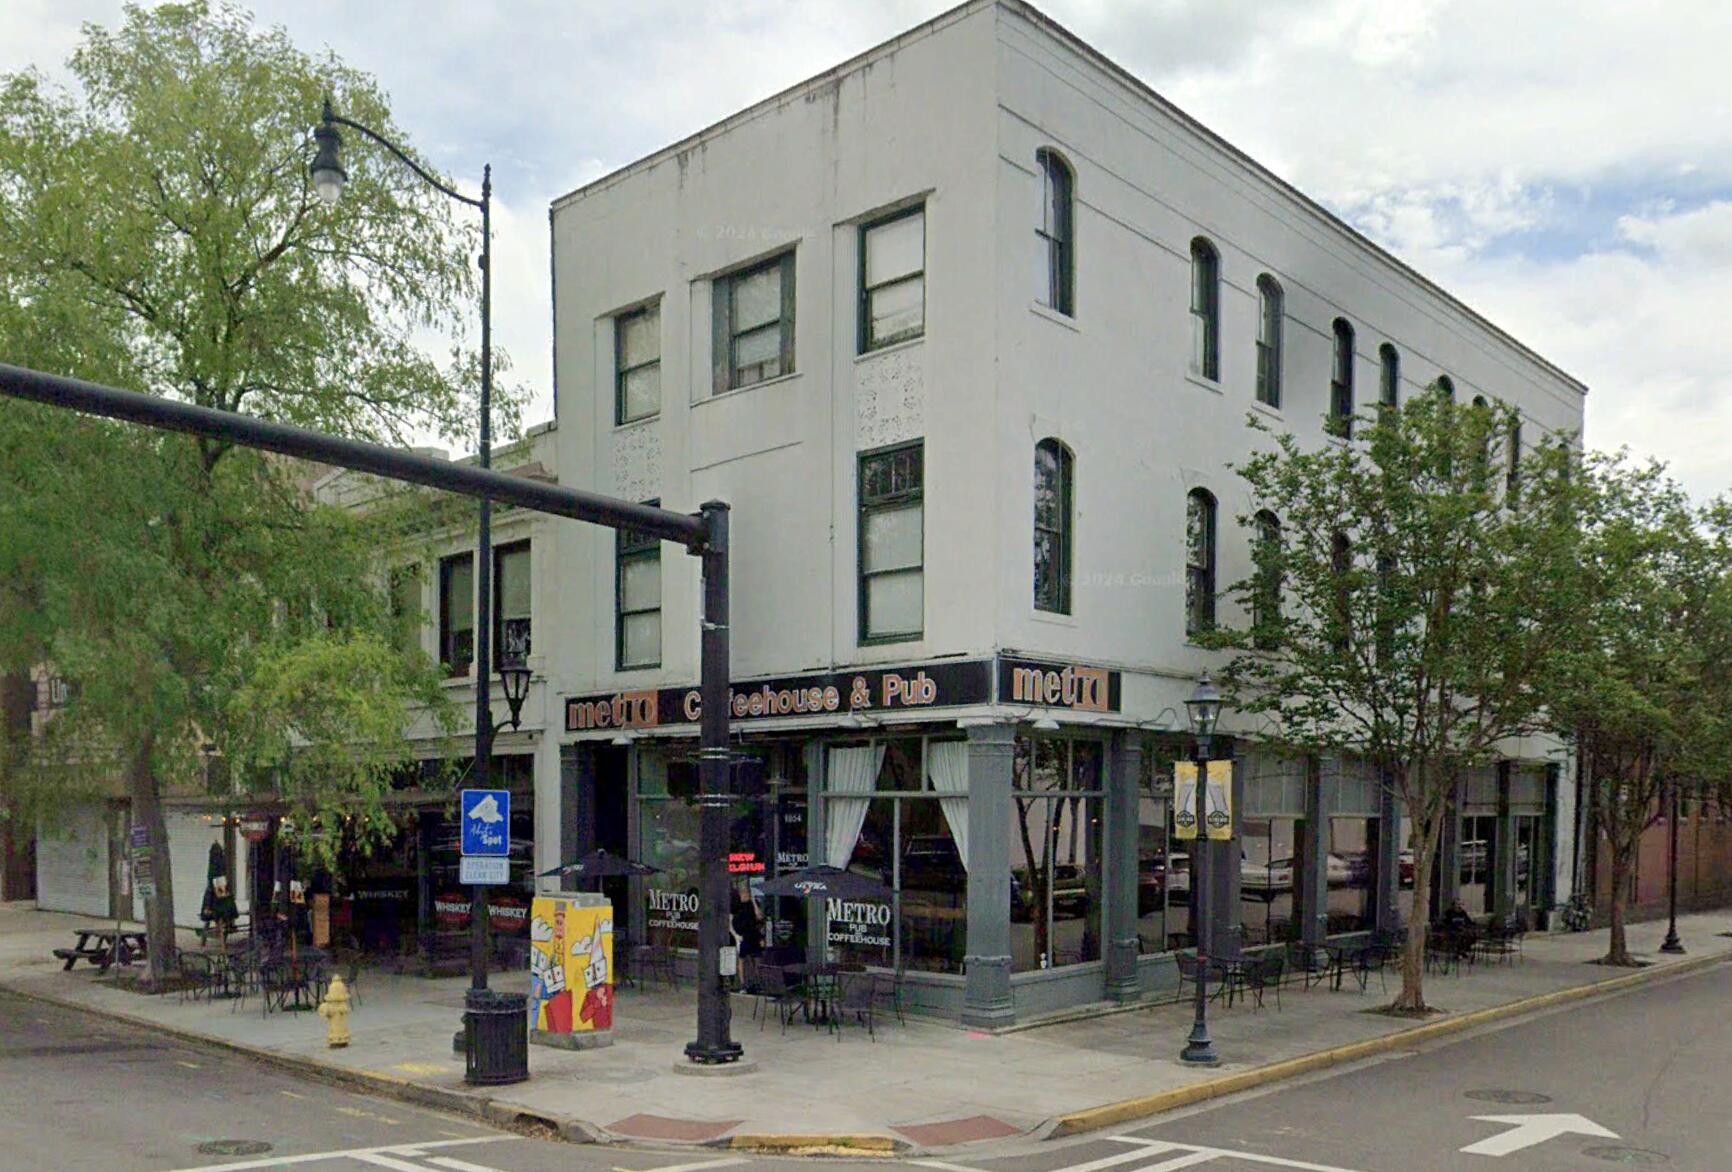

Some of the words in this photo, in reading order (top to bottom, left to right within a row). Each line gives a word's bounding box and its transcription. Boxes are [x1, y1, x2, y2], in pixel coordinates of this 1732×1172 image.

[1013, 666, 1107, 710] metro
[569, 691, 657, 729] metro
[684, 685, 840, 720] Ceehouse
[850, 676, 870, 708] &
[883, 671, 937, 706] Pub
[434, 900, 472, 914] WHISKEY
[648, 889, 699, 912] METRO
[487, 904, 527, 918] WHISKEY
[827, 897, 890, 925] METRO
[849, 923, 867, 933] PUB
[827, 932, 891, 946] COFFEEHOUSE
